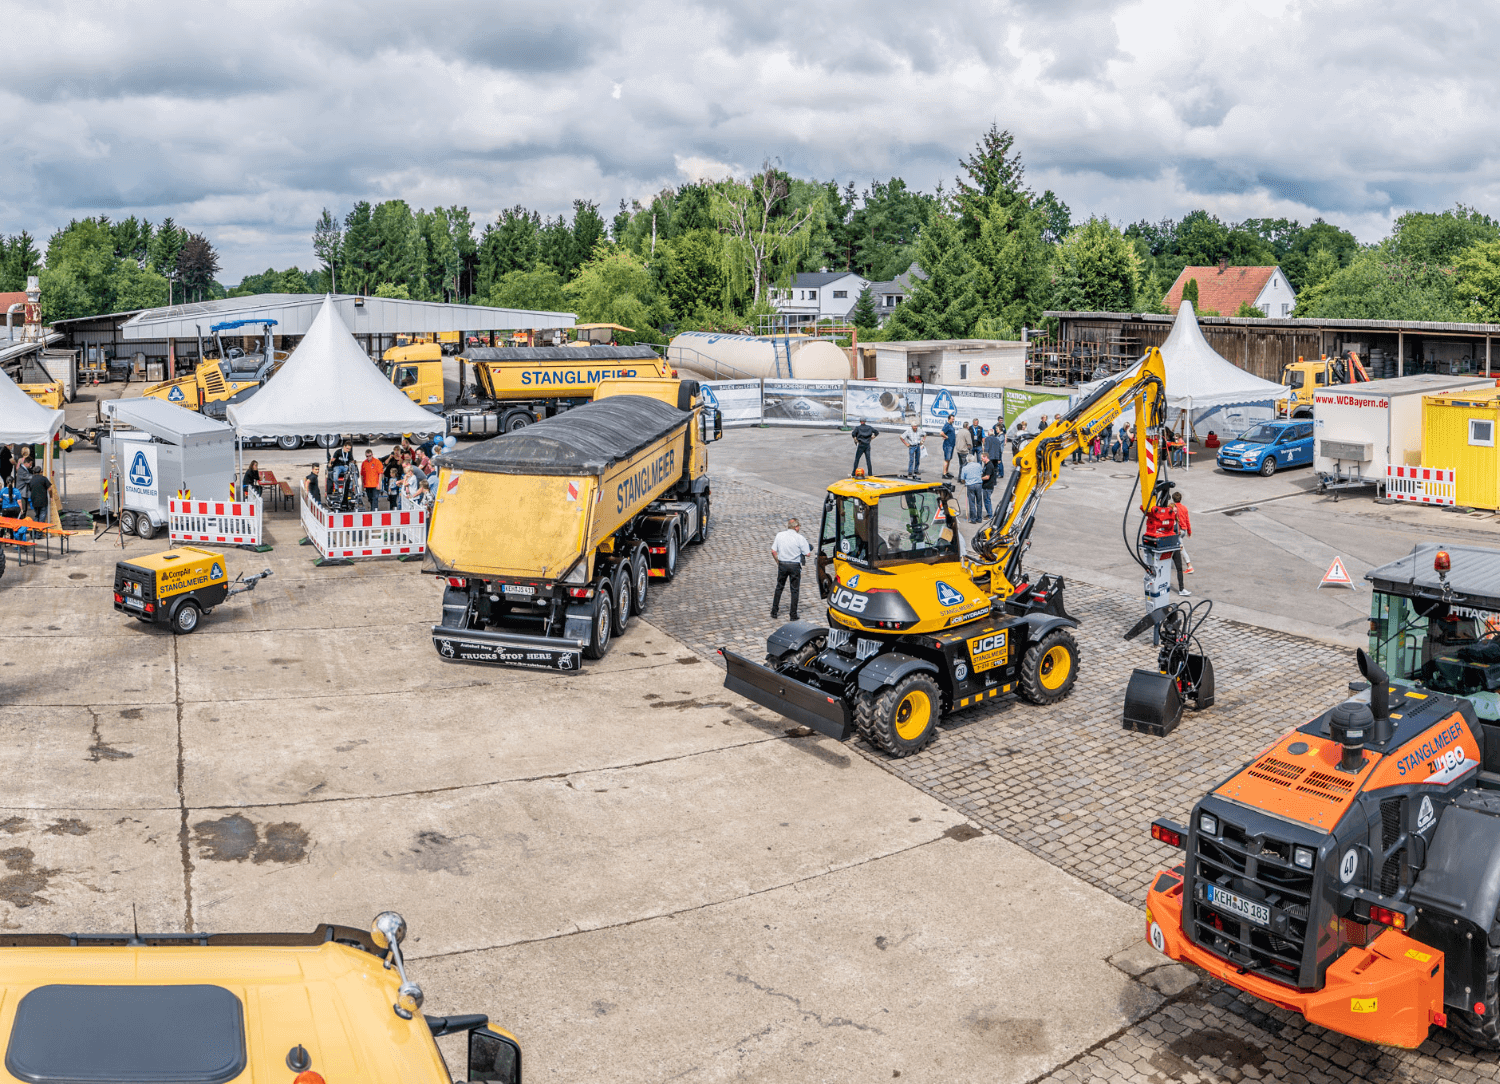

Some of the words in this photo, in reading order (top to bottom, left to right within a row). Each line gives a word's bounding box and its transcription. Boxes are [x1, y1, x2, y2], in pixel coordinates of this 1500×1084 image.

[1006, 392, 1027, 401] STATION
[1315, 395, 1389, 409] www.WCBayern.de
[617, 448, 675, 515] STANGLMEIER
[125, 486, 158, 497] STANGLMEIER
[842, 540, 850, 550] 20
[168, 568, 191, 579] CompAir
[160, 575, 209, 594] STANGLMEIER
[830, 587, 869, 613] JCB
[940, 603, 975, 617] STANGLMEIER
[973, 633, 1006, 654] JCB
[973, 648, 1007, 664] STANGLMEIER
[958, 668, 965, 677] 20
[1396, 722, 1464, 776] STANGLMEIER
[1344, 855, 1354, 876] 40
[1214, 888, 1233, 905] KEH
[1237, 901, 1249, 914] JS
[1251, 906, 1269, 921] 183
[1154, 930, 1163, 949] 40
